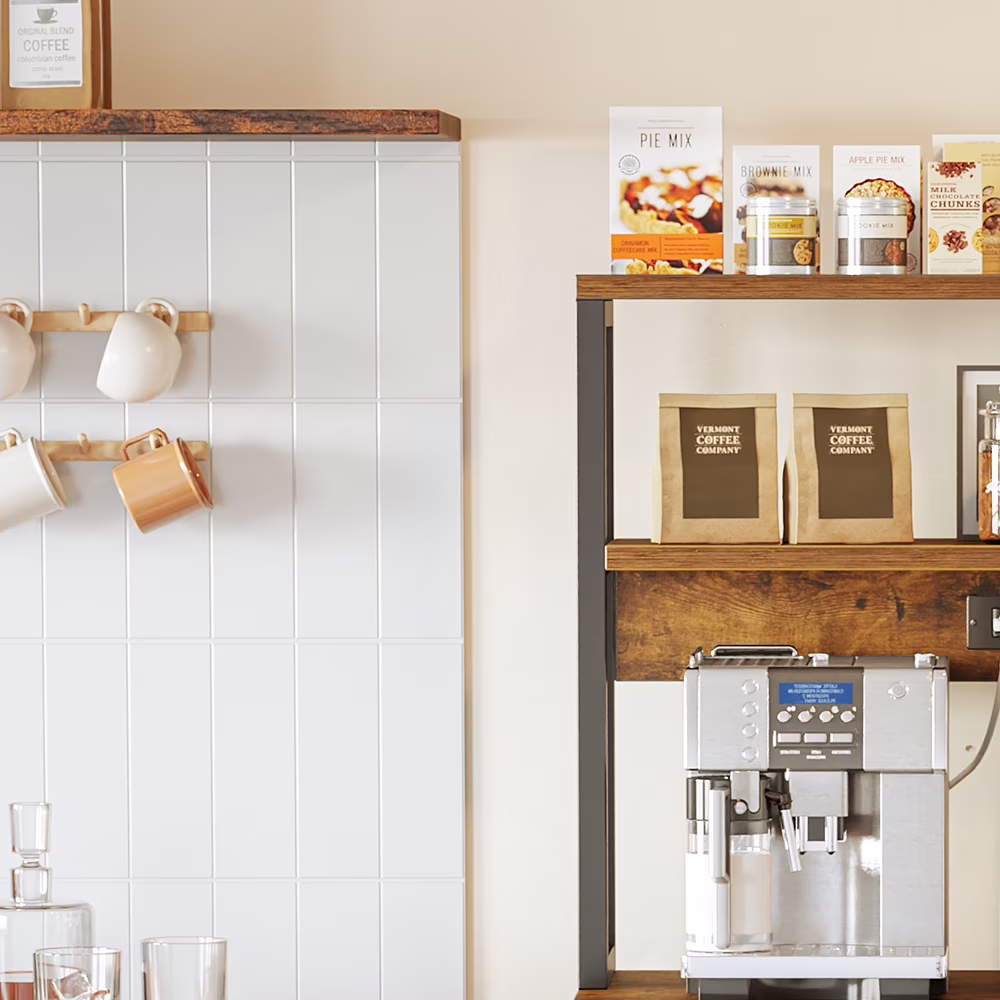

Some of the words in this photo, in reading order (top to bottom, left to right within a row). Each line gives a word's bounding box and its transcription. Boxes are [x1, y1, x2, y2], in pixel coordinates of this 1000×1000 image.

[50, 27, 74, 35] BLEND
[24, 39, 69, 52] COFFEE
[54, 54, 76, 62] coffee
[640, 133, 660, 148] PIE
[669, 133, 692, 148] MIX
[849, 156, 873, 164] APPLE
[876, 156, 888, 164] PIE
[890, 156, 905, 164] MIX
[741, 166, 788, 178] BROWNIE
[794, 166, 812, 178] MIX
[930, 200, 980, 208] CHUNKS
[696, 436, 740, 444] COFFEE
[830, 436, 873, 444] COFFEE
